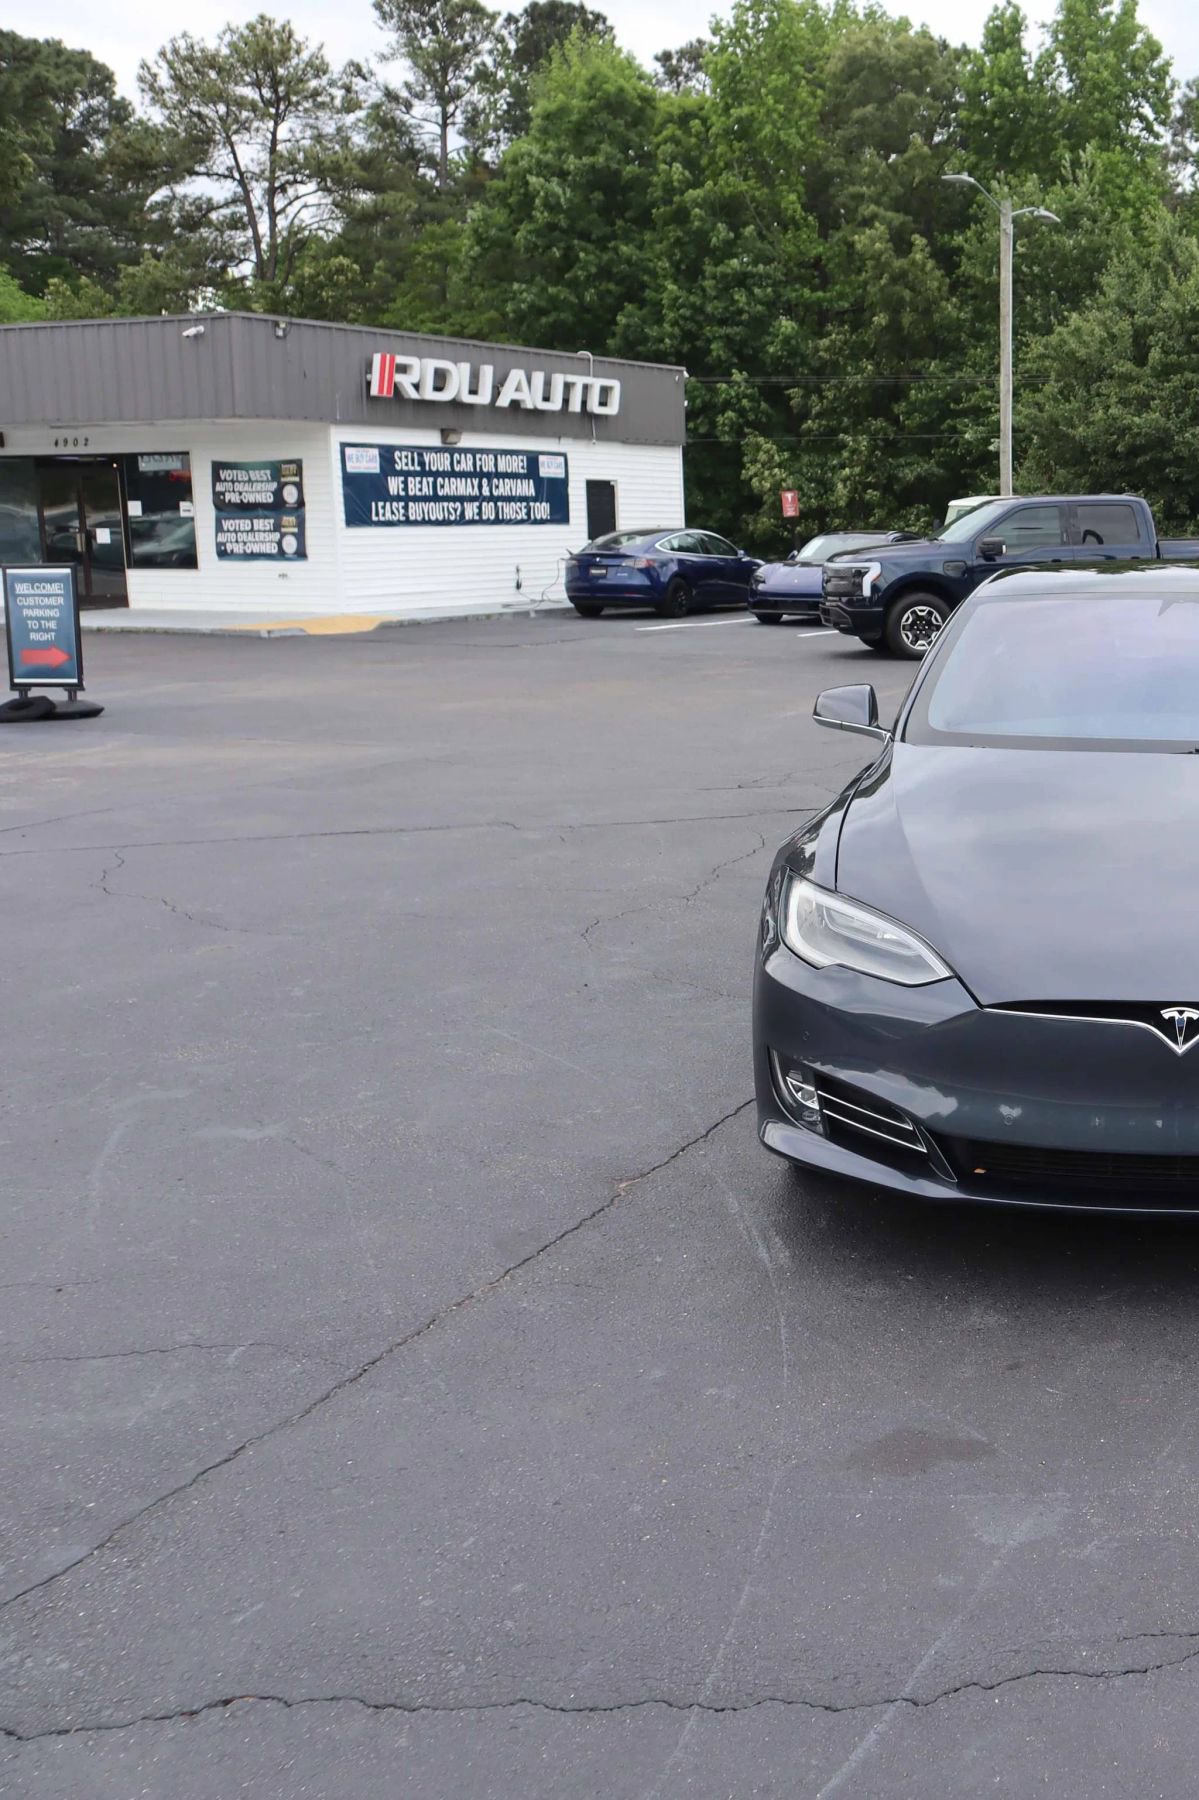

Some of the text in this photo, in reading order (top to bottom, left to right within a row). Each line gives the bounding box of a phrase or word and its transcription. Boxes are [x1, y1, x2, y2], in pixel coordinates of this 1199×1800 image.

[494, 368, 620, 416] AUTO
[394, 451, 421, 471] SELL
[423, 452, 452, 472] YOUR
[453, 453, 474, 472] CAR
[475, 453, 496, 473] FOR
[497, 454, 527, 473] MORE!
[219, 469, 249, 481] VOTED
[249, 469, 272, 481] BEST
[215, 481, 278, 492] AUTO DEALERSHIP
[388, 476, 536, 496] WE BEAT CARMAX & CARVANA
[225, 492, 274, 503] PRE-OWNED
[371, 501, 551, 521] LEASE BUYOUTS? WE DO THOSE TOO!
[221, 519, 252, 531] VOTED
[253, 519, 275, 531] BEST
[217, 531, 280, 542] AUTO DEALERSHIP
[226, 542, 278, 554] PRE-OWNED
[14, 582, 64, 594] WELCOME!
[16, 596, 64, 606] CUSTOMER
[22, 608, 60, 618] PARKING
[26, 620, 57, 630] TO THE
[29, 632, 56, 642] RIGHT
